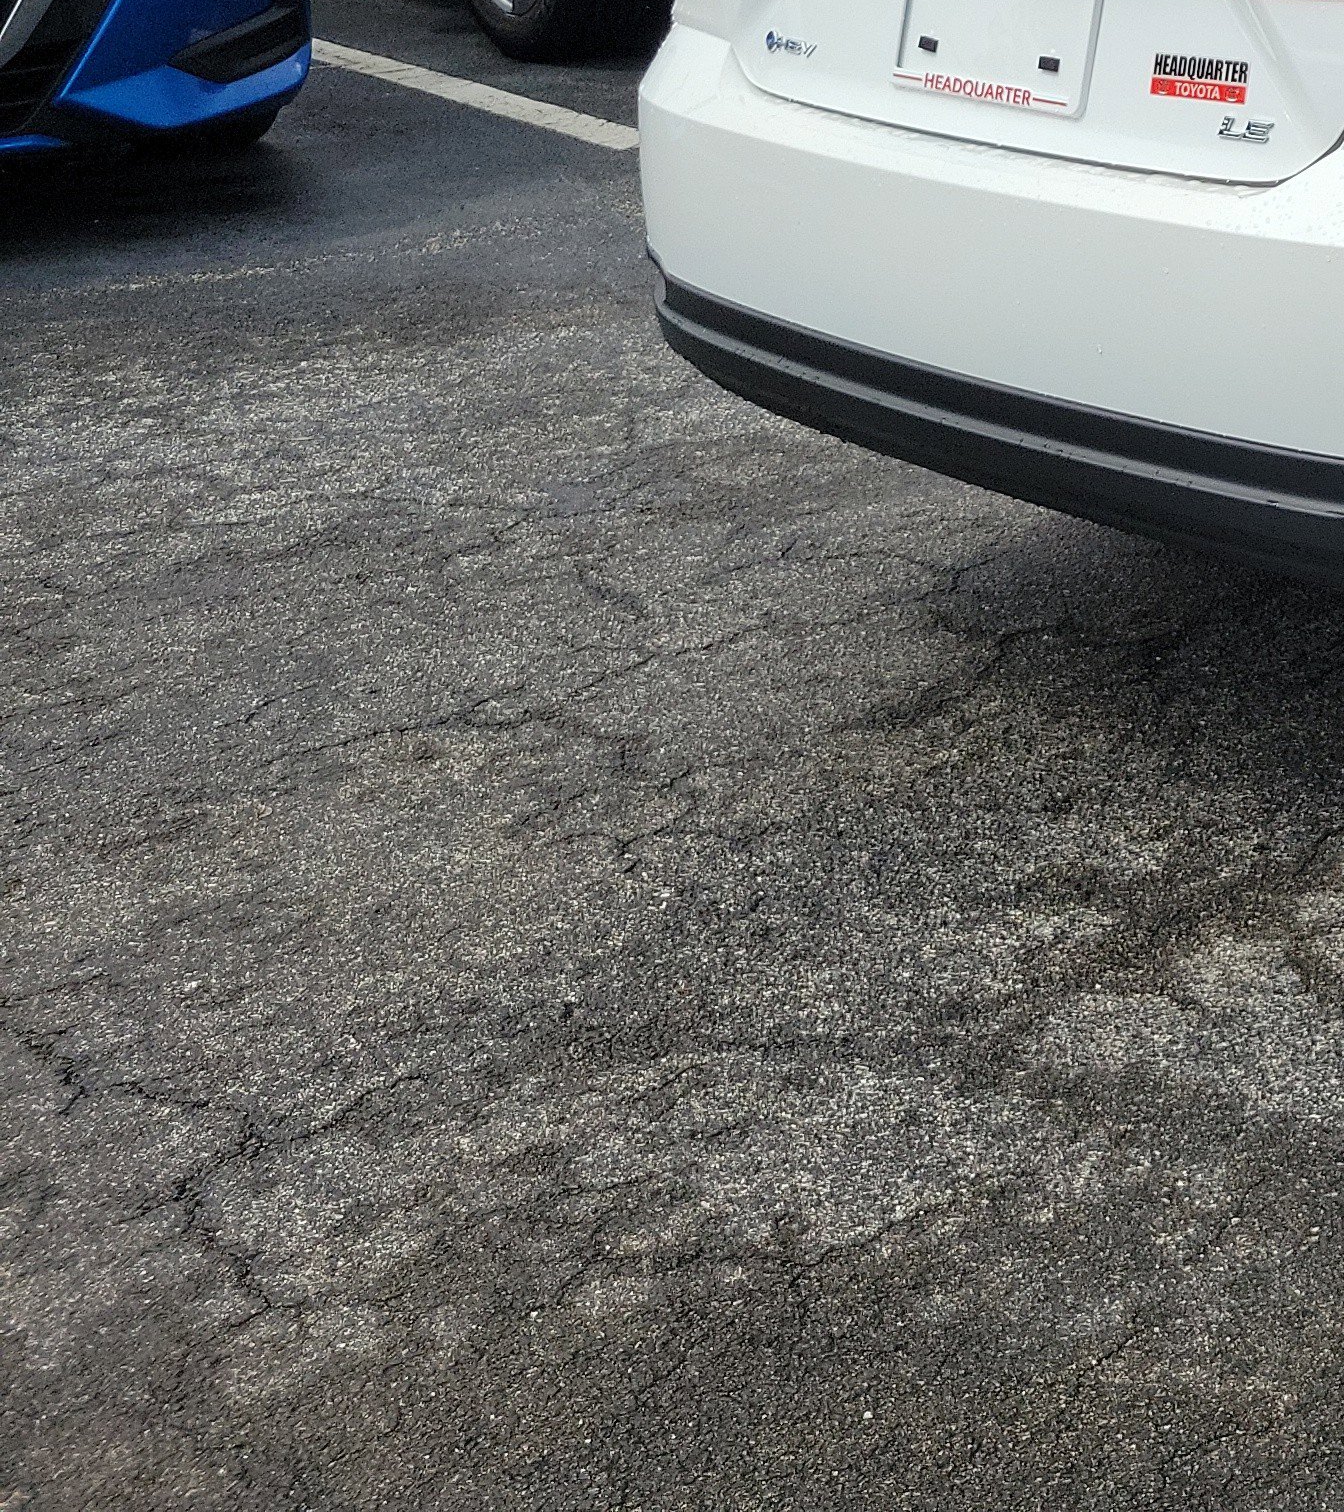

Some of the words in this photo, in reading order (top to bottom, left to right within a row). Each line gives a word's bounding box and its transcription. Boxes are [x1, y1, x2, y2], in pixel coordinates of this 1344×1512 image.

[1153, 53, 1249, 84] HEADQUARTER
[924, 72, 1032, 106] HEADQUARTER
[1174, 81, 1221, 100] TOYOTA
[1217, 115, 1276, 144] LE
